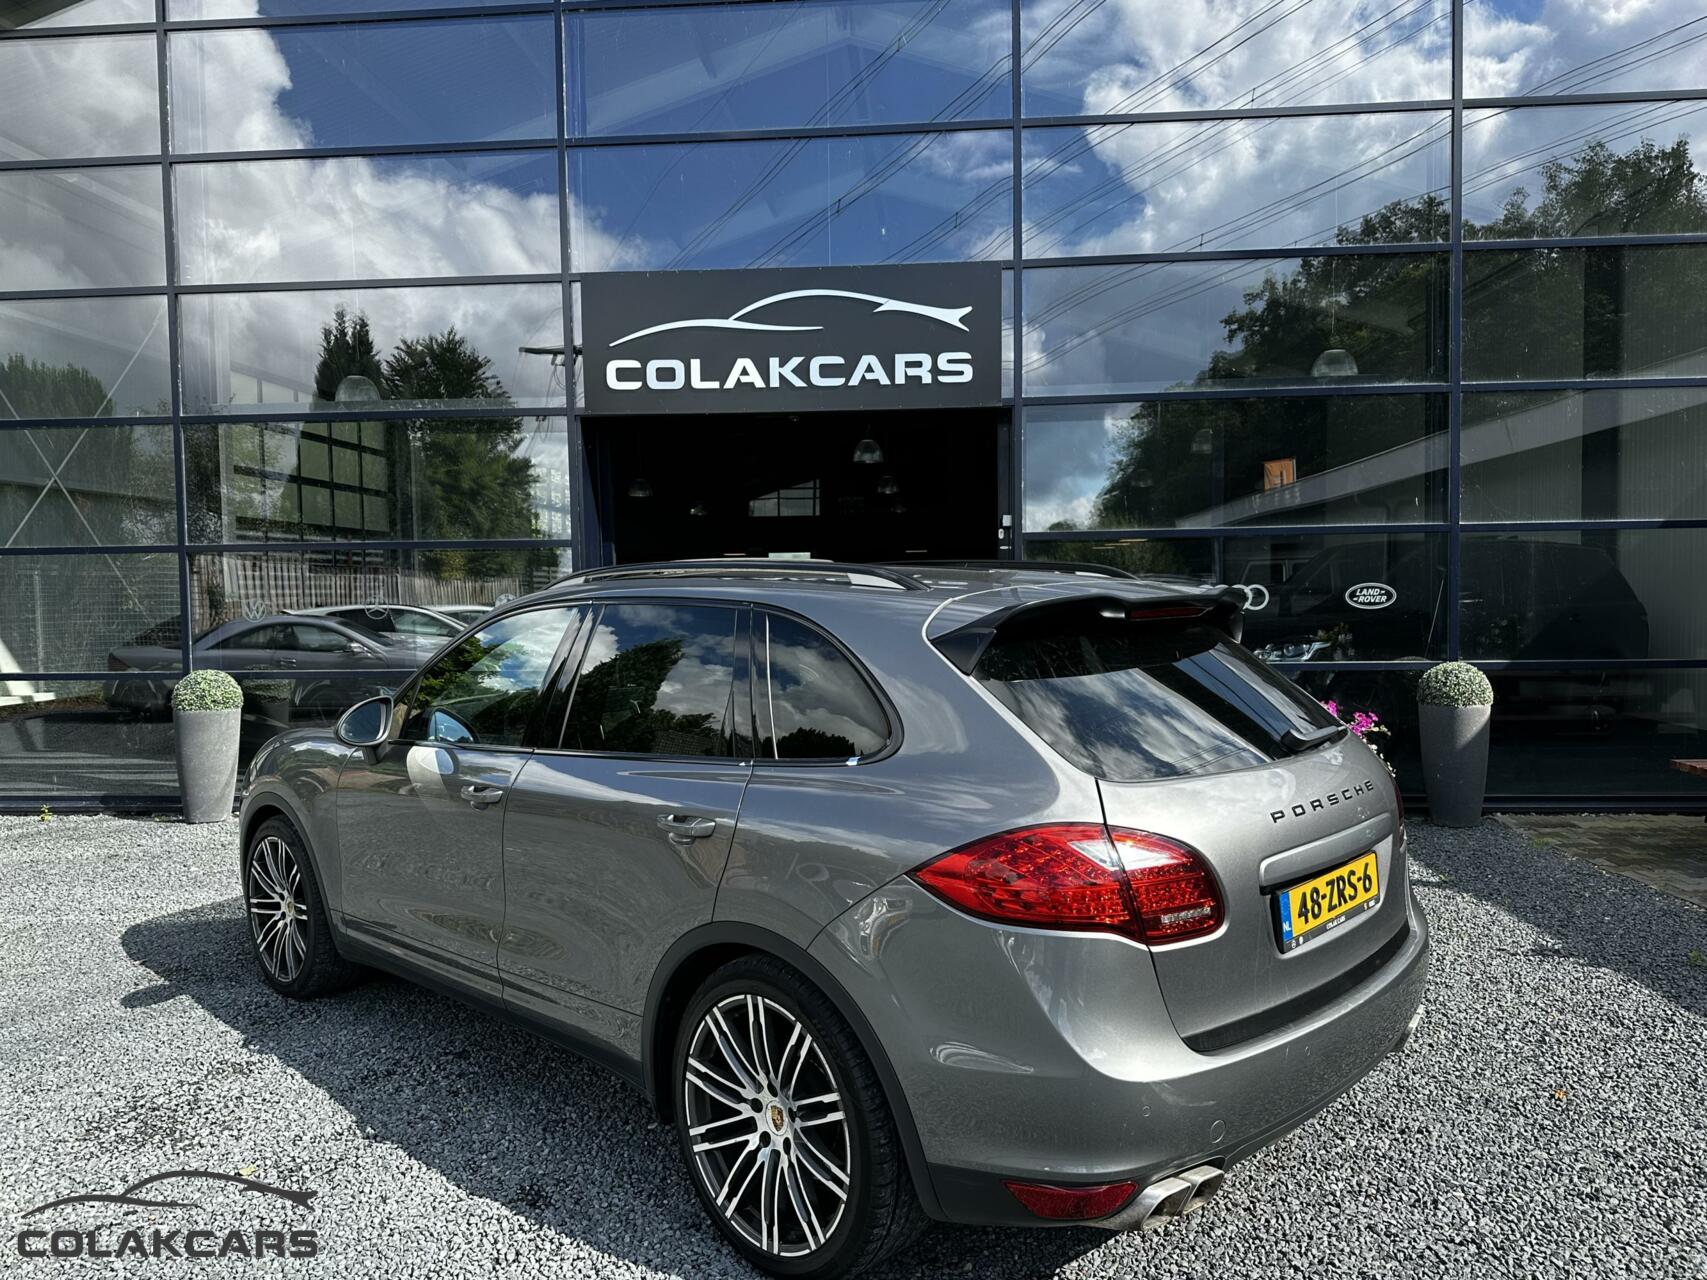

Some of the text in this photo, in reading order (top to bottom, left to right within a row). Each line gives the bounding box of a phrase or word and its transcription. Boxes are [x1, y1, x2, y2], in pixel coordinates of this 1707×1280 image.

[605, 351, 974, 391] COLAKCARS
[1270, 780, 1374, 823] PORSCHE
[1297, 862, 1373, 925] 48-ZRS-6
[1283, 920, 1292, 933] NL
